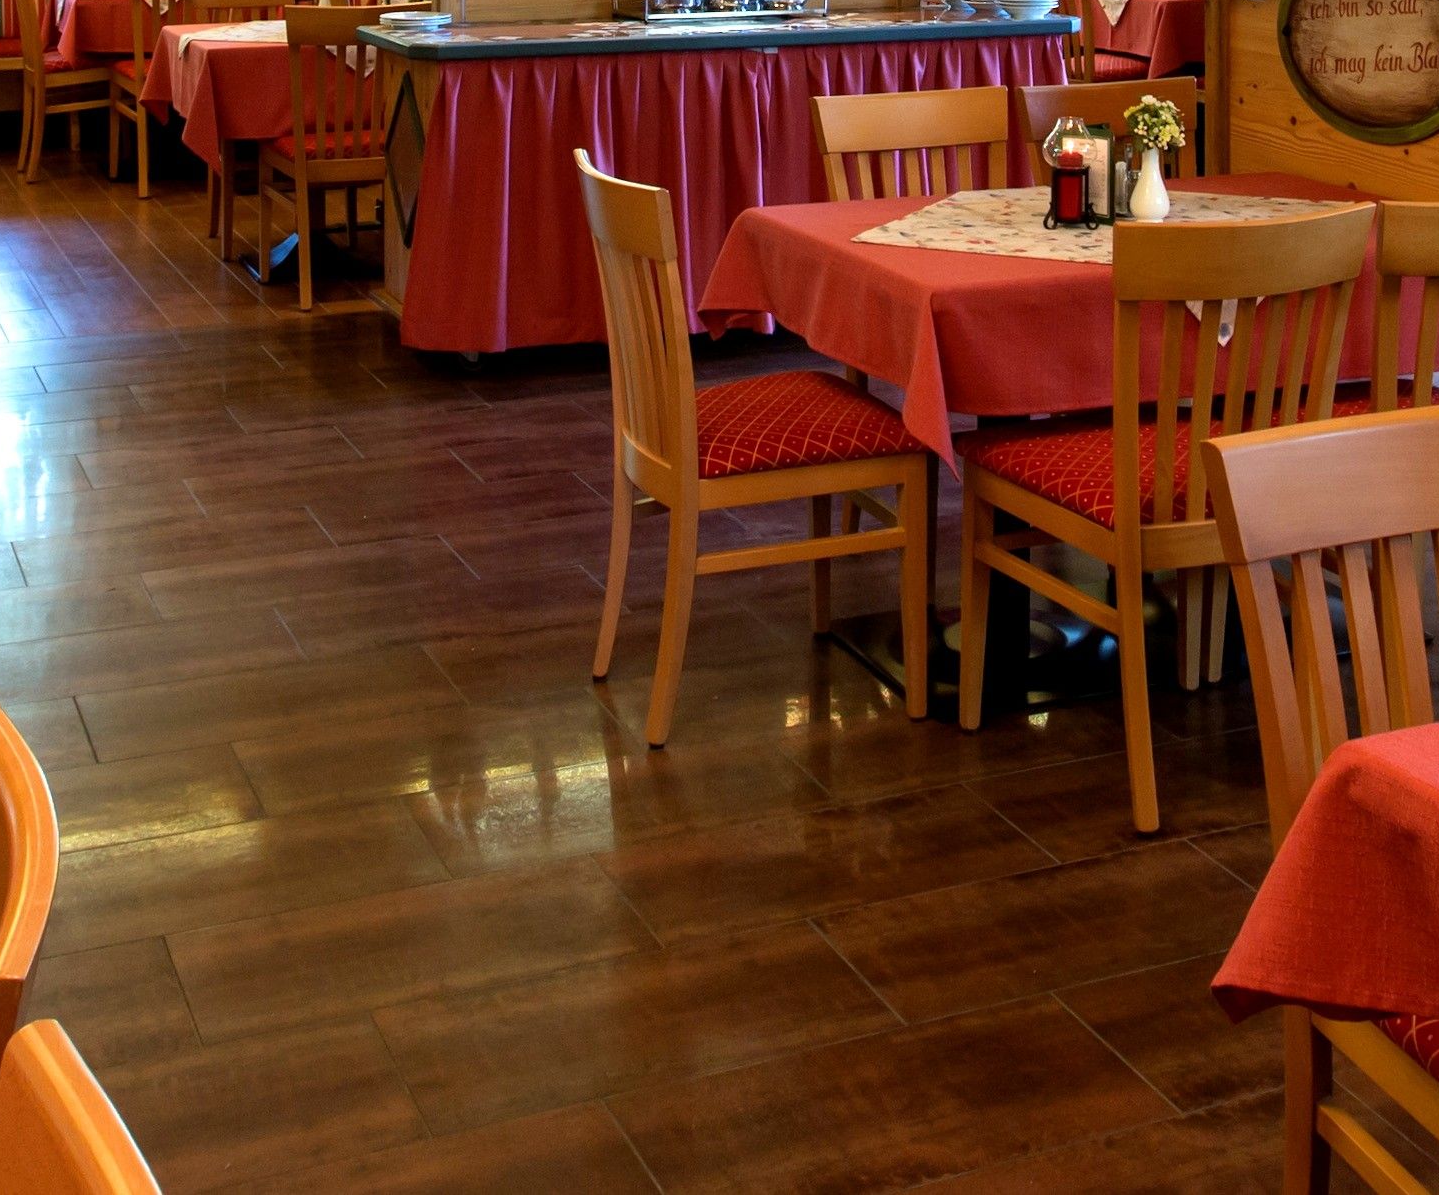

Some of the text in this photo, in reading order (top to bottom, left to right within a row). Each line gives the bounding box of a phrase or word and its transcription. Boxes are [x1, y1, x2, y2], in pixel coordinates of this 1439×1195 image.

[1366, 0, 1384, 16] so
[1310, 46, 1328, 75] ich
[1334, 56, 1366, 84] mag
[1374, 44, 1403, 72] kein
